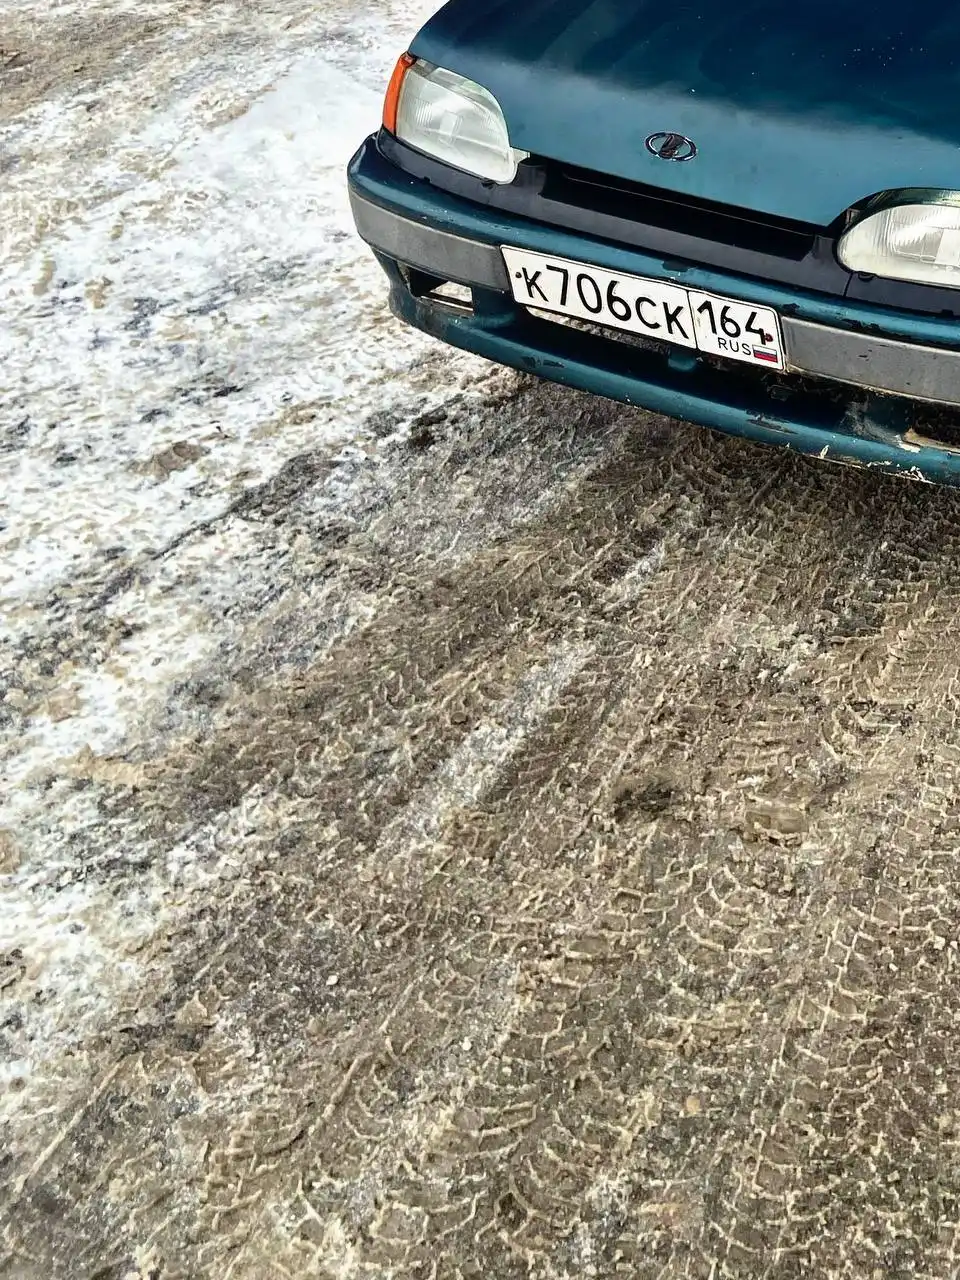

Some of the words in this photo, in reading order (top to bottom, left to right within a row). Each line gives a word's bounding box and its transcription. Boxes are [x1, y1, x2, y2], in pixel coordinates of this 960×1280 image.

[521, 264, 690, 339] К706СК
[697, 300, 767, 345] 164
[718, 337, 752, 356] RUS
